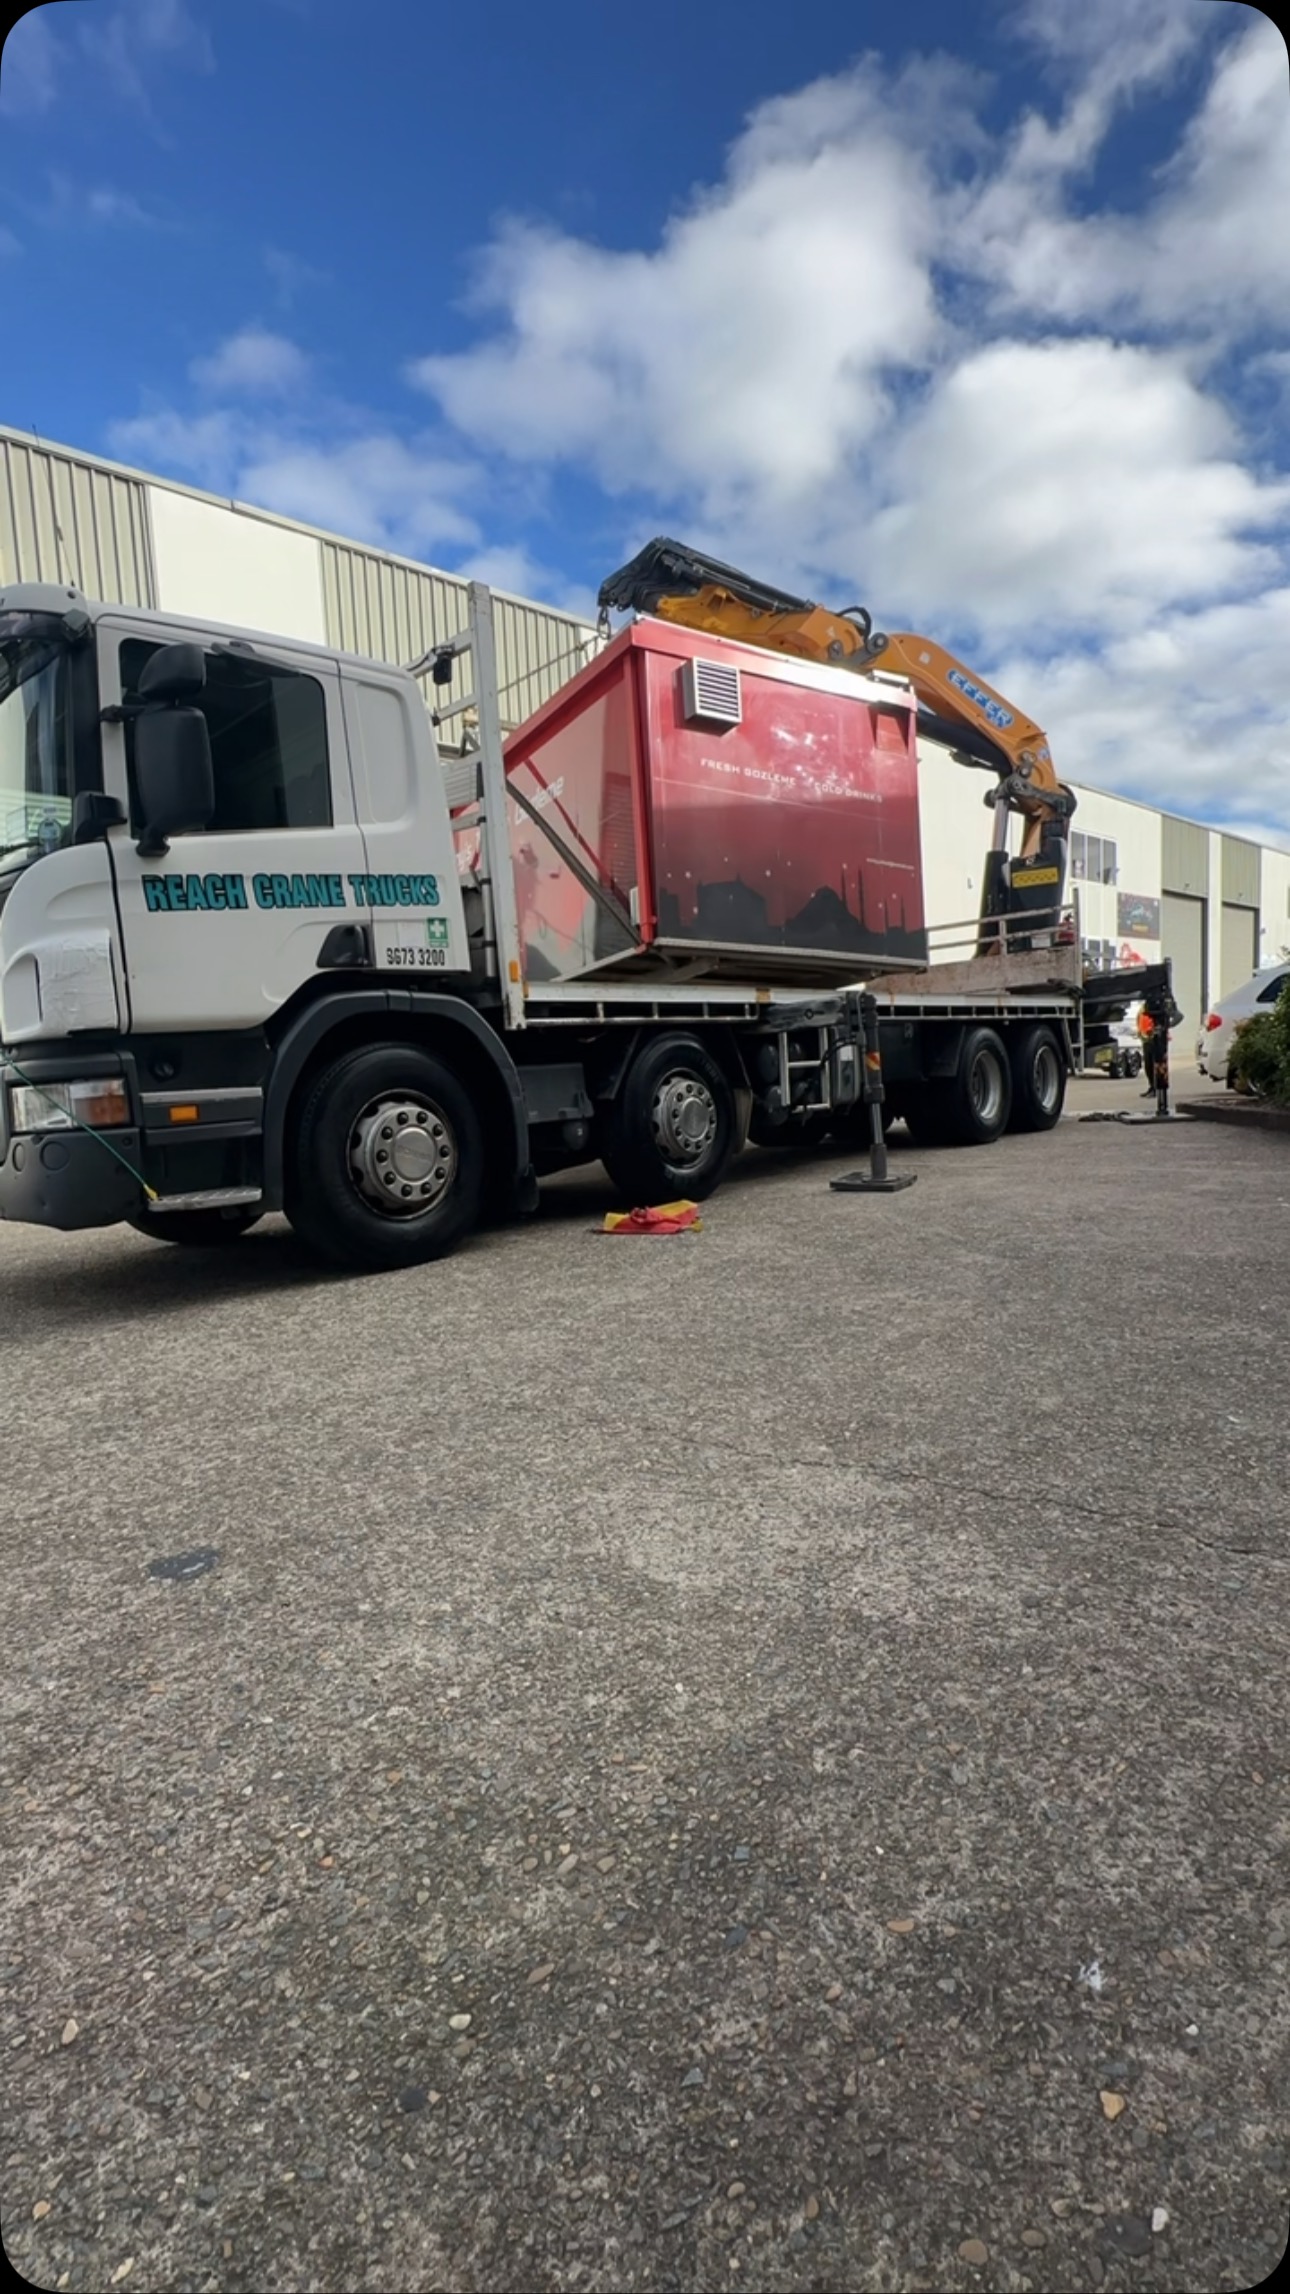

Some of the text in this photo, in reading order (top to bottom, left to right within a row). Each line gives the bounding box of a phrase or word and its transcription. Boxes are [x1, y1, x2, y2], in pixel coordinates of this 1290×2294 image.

[700, 757, 740, 774] FRESH
[142, 872, 440, 912] REACH CRANE TRUCKS
[418, 948, 445, 967] 3200
